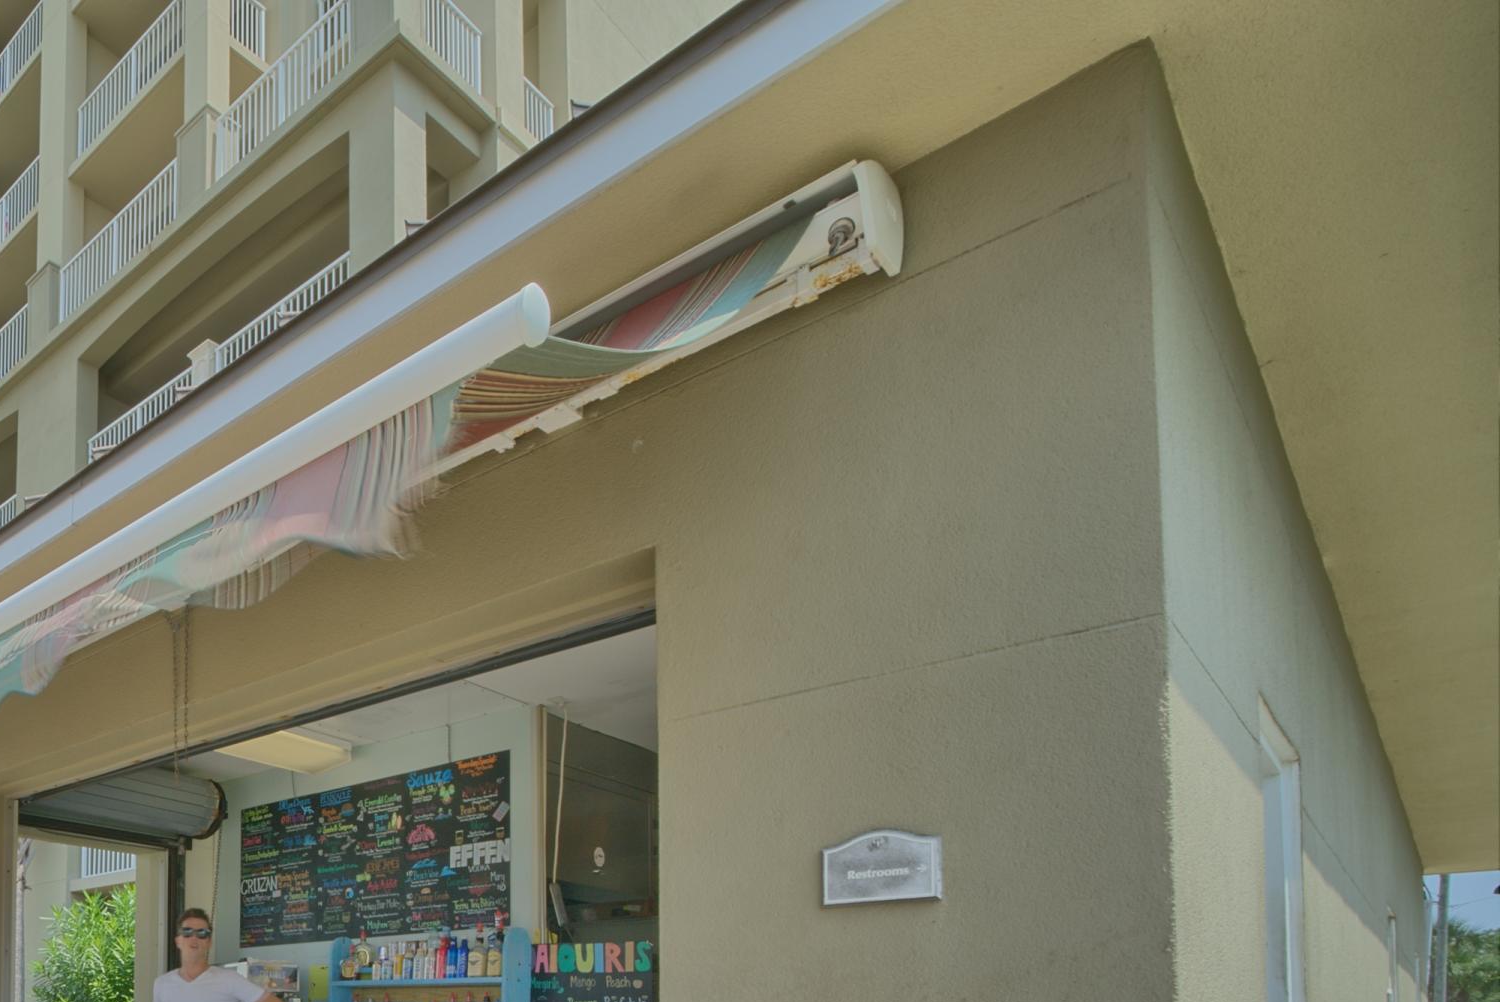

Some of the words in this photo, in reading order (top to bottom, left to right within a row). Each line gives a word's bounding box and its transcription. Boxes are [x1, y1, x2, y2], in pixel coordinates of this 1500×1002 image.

[450, 839, 510, 868] EFFEN
[847, 866, 910, 880] Restrooms
[241, 876, 277, 895] CRUZAN
[531, 940, 652, 973] AIQUIRIS
[570, 976, 596, 991] Mango
[605, 975, 631, 988] Peach
